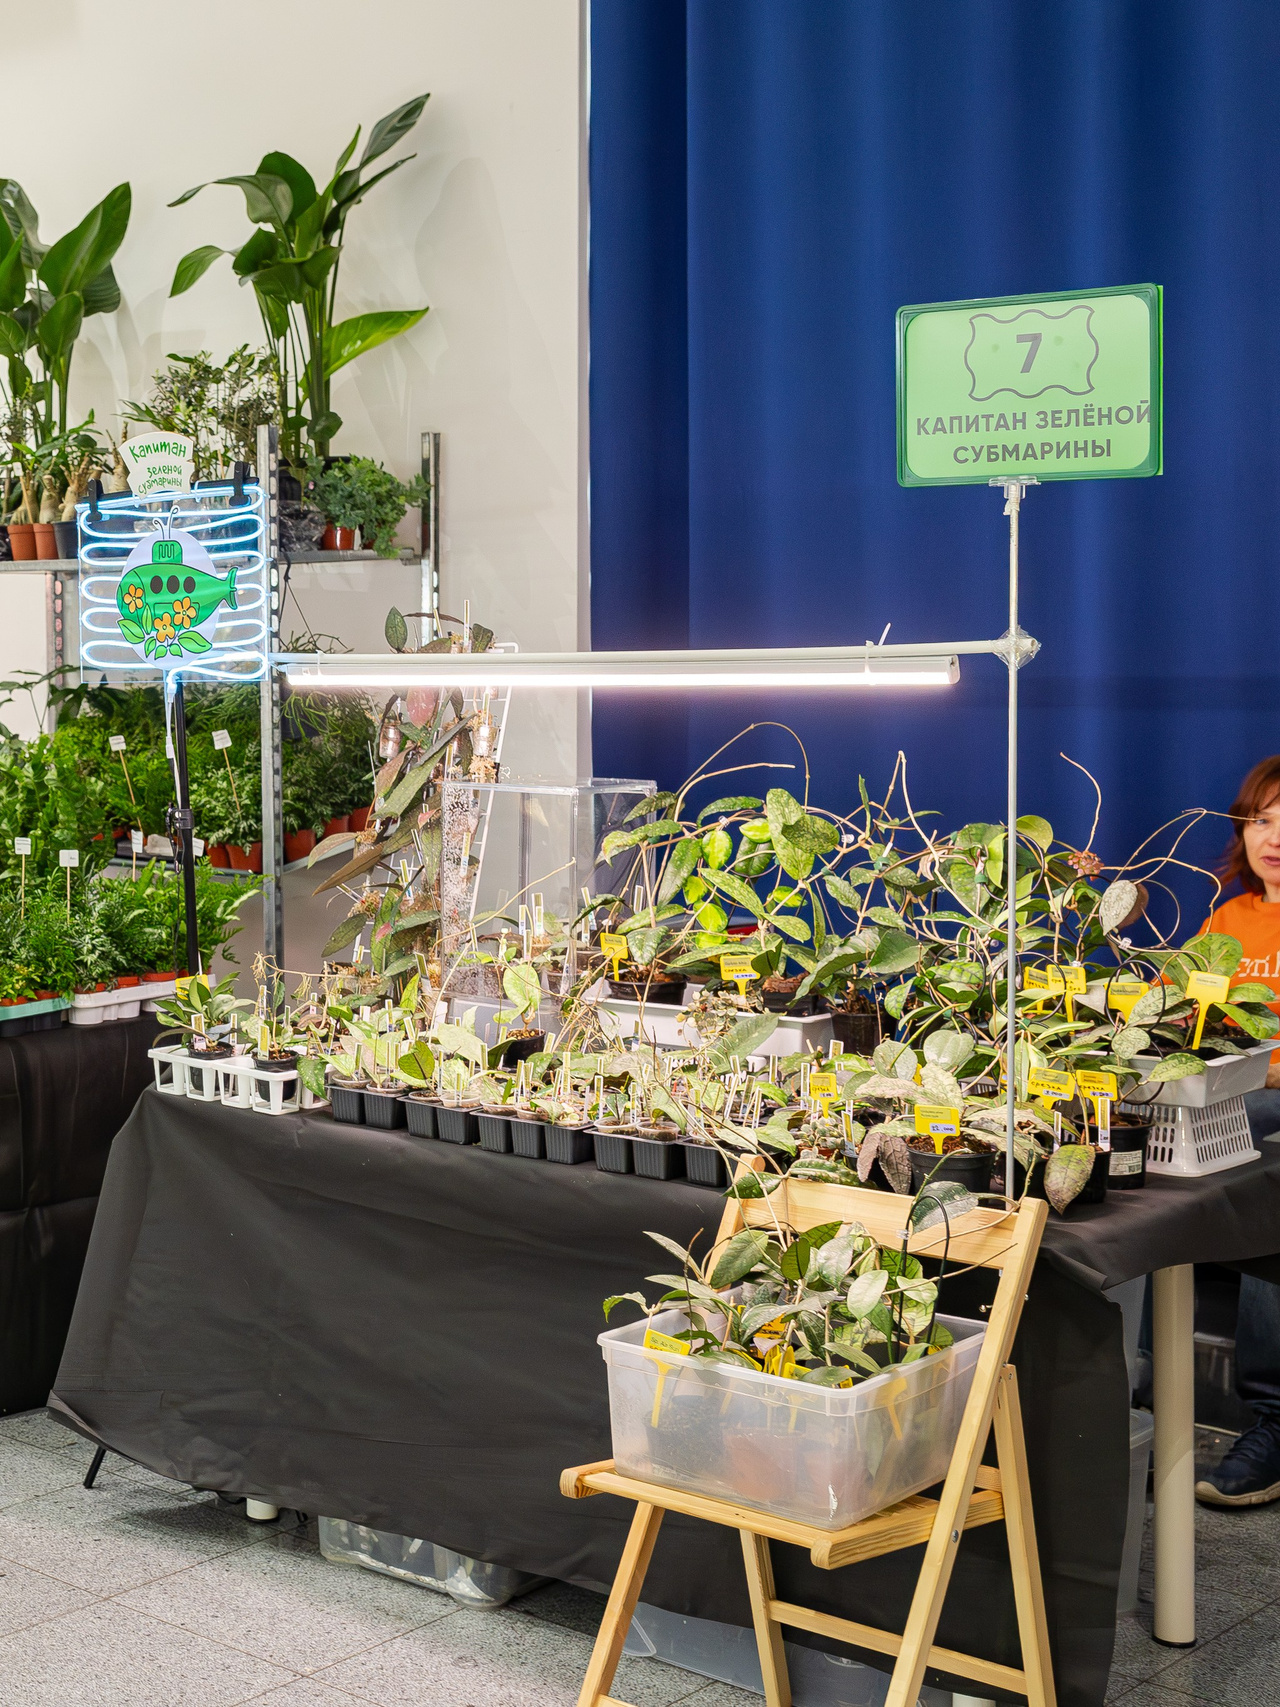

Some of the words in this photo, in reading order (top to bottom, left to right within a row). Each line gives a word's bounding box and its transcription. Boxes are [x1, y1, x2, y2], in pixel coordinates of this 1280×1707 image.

[1016, 332, 1042, 373] 7
[916, 411, 1027, 436] КАПИТАН
[1035, 399, 1151, 429] ЗЕЛЁНОЙ
[128, 441, 187, 463] Капитан
[953, 438, 1112, 464] СУБМАРИНЫ
